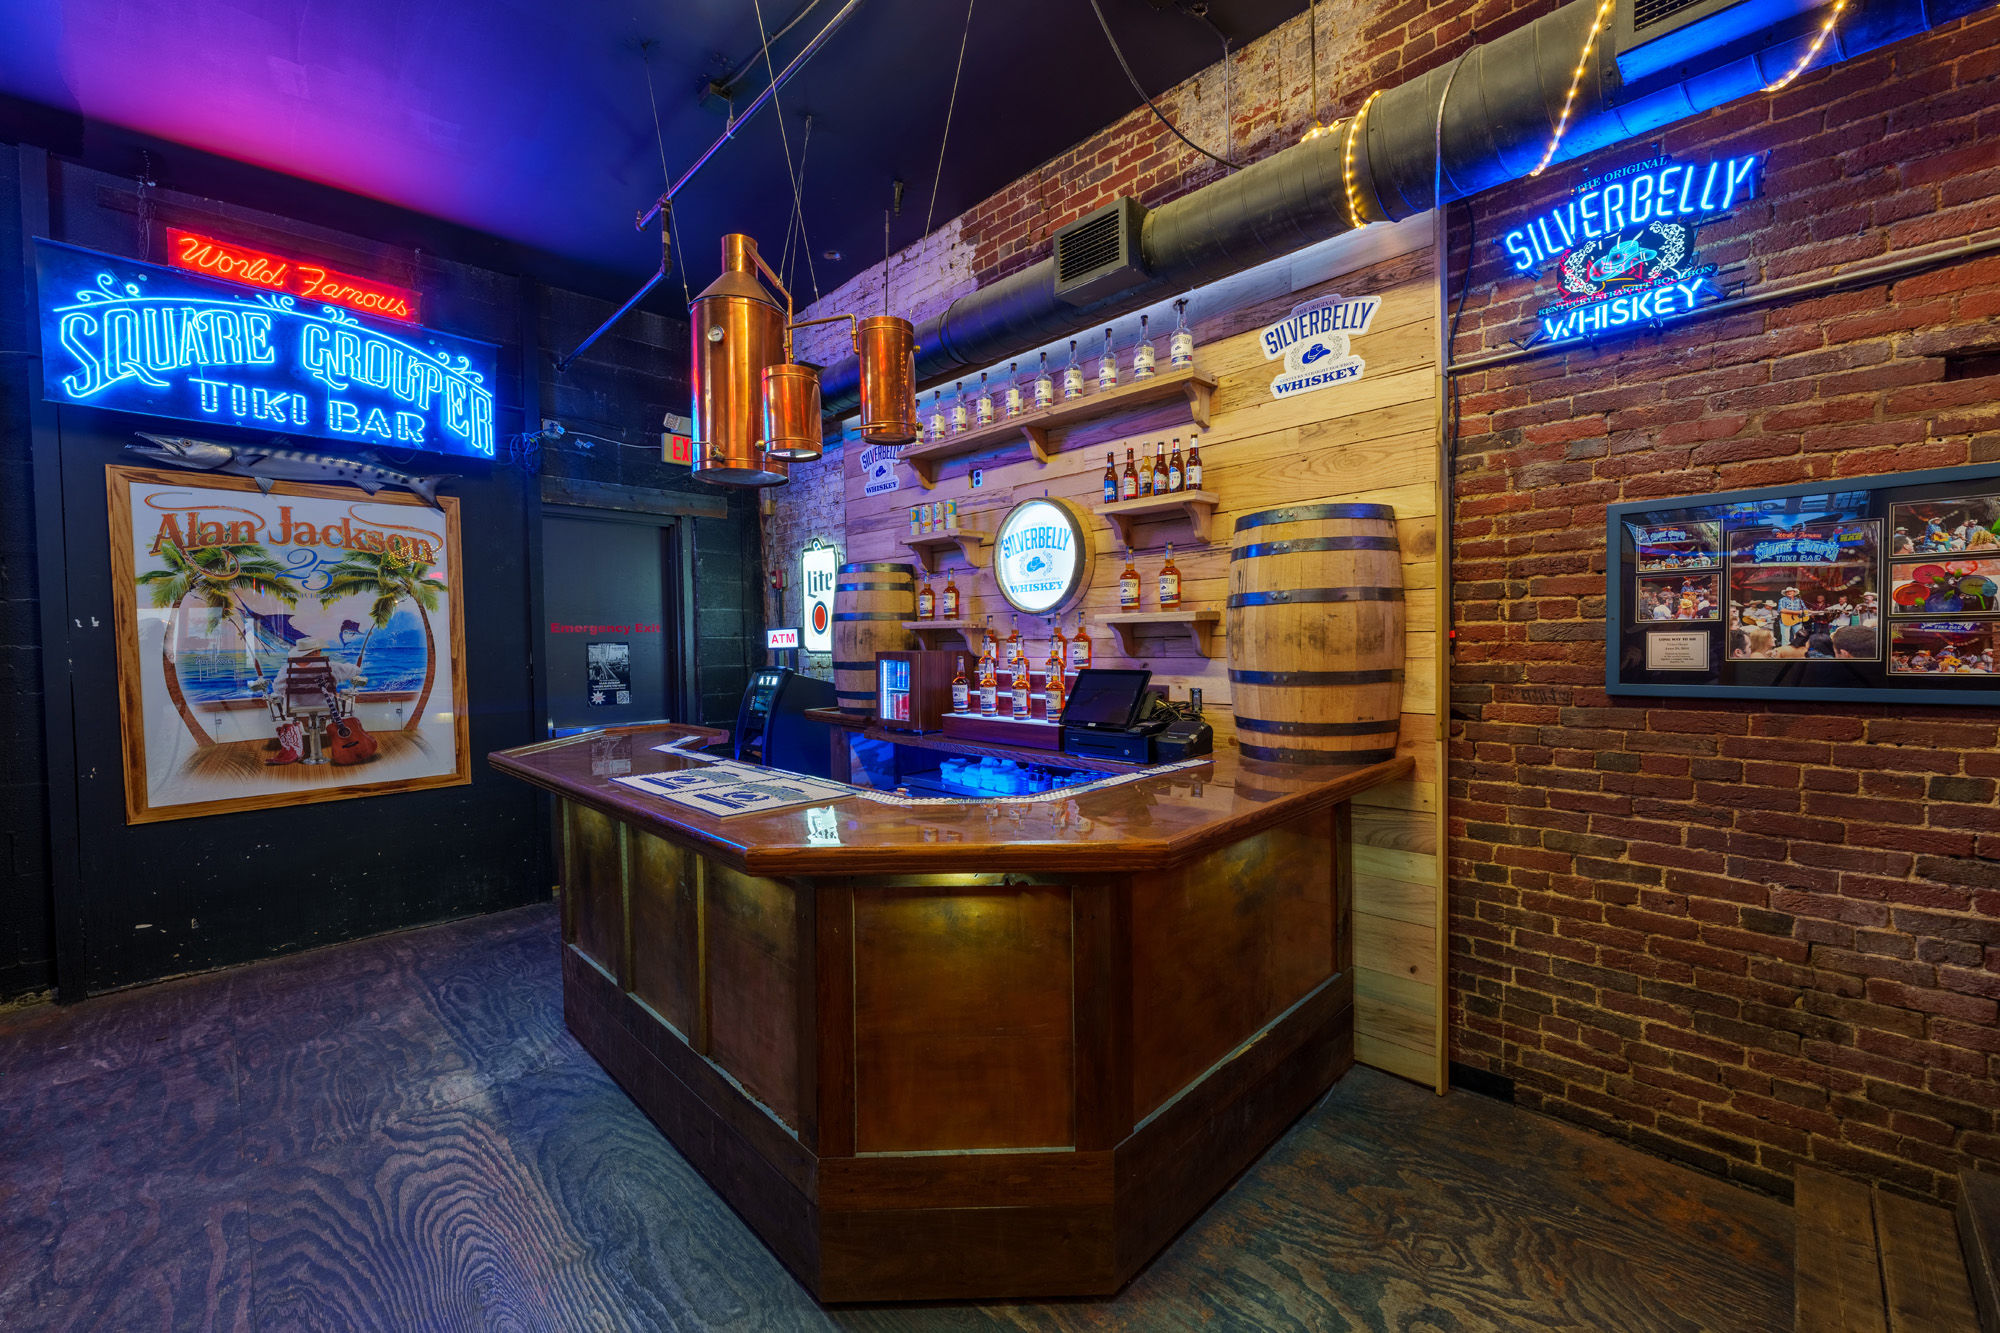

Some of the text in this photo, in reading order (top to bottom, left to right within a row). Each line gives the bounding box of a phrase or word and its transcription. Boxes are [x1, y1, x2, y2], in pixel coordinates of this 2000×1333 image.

[1574, 156, 1669, 195] THE ORIGINAL
[1504, 156, 1754, 271] SILVERBELLY
[178, 237, 408, 317] World Famous
[1308, 298, 1337, 311] ORIGINAL
[1537, 295, 1593, 317] KENTUCKY
[1593, 282, 1652, 302] STRAIGHT
[1545, 277, 1704, 341] WHISKEY
[1265, 301, 1375, 355] SILVERBELLY
[61, 307, 495, 457] SQUARE GROUPER
[1275, 364, 1360, 394] WHISKEY
[188, 377, 427, 444] TIKI BAR
[865, 481, 898, 494] WHISKEY
[149, 505, 438, 568] Alan Jackson
[1001, 526, 1073, 559] SILVERBELLY
[273, 548, 344, 592] 25
[807, 569, 833, 599] Lite
[1009, 581, 1064, 594] WHISKEY
[550, 622, 662, 636] Emergency Exit
[771, 632, 796, 645] ATM
[758, 676, 779, 686] ATM
